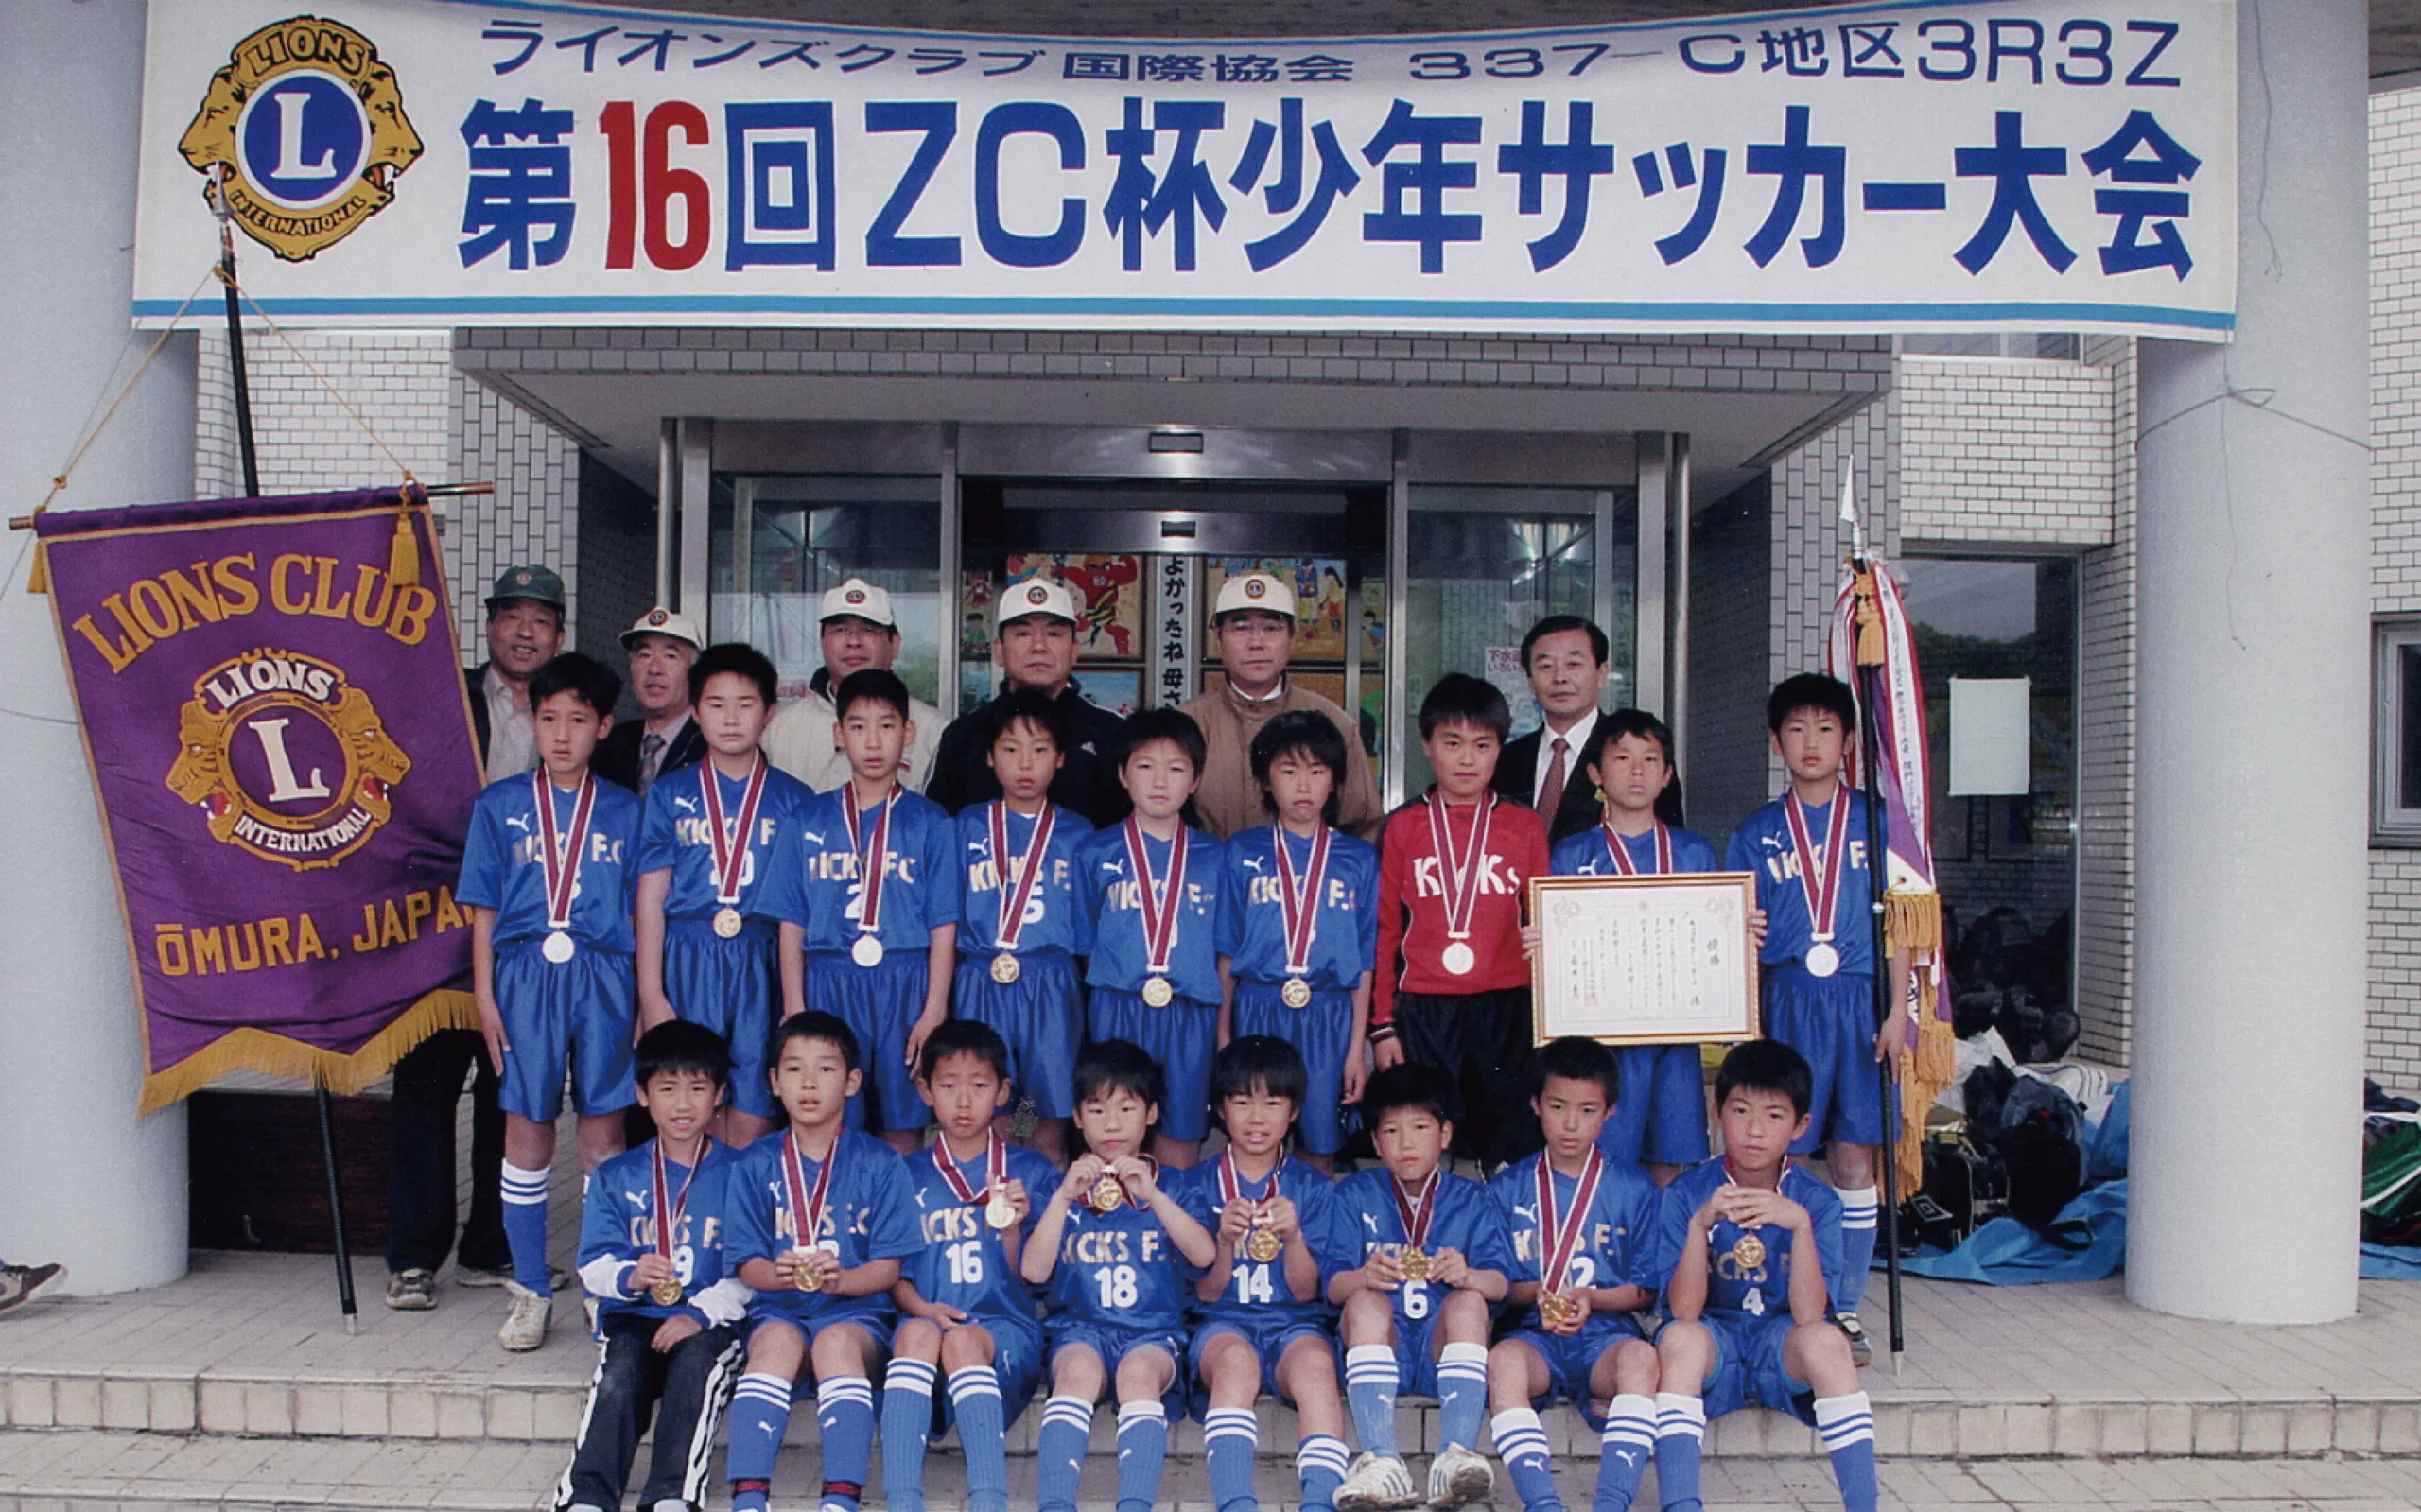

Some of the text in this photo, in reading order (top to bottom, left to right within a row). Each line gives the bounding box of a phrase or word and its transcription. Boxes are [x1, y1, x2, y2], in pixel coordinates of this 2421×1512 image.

[245, 26, 366, 77] LIONS
[482, 19, 1354, 82] ライオンズクラブ国際協会
[270, 92, 338, 179] L
[229, 188, 368, 236] INTERNATIONAL
[458, 96, 2203, 282] 第16回ZC杯少年サッカー大会
[72, 552, 438, 674] LIONS CLUB
[204, 657, 336, 710] LIONS
[249, 718, 331, 803] L
[234, 807, 374, 853] INTERNATIONAL
[675, 816, 739, 847] KICK
[353, 885, 475, 956] JAPA
[945, 1240, 984, 1284] 16
[1093, 1263, 1138, 1309] 18
[1232, 1263, 1273, 1304] 14
[1403, 1278, 1429, 1320] 6
[1742, 1287, 1766, 1317] 4
